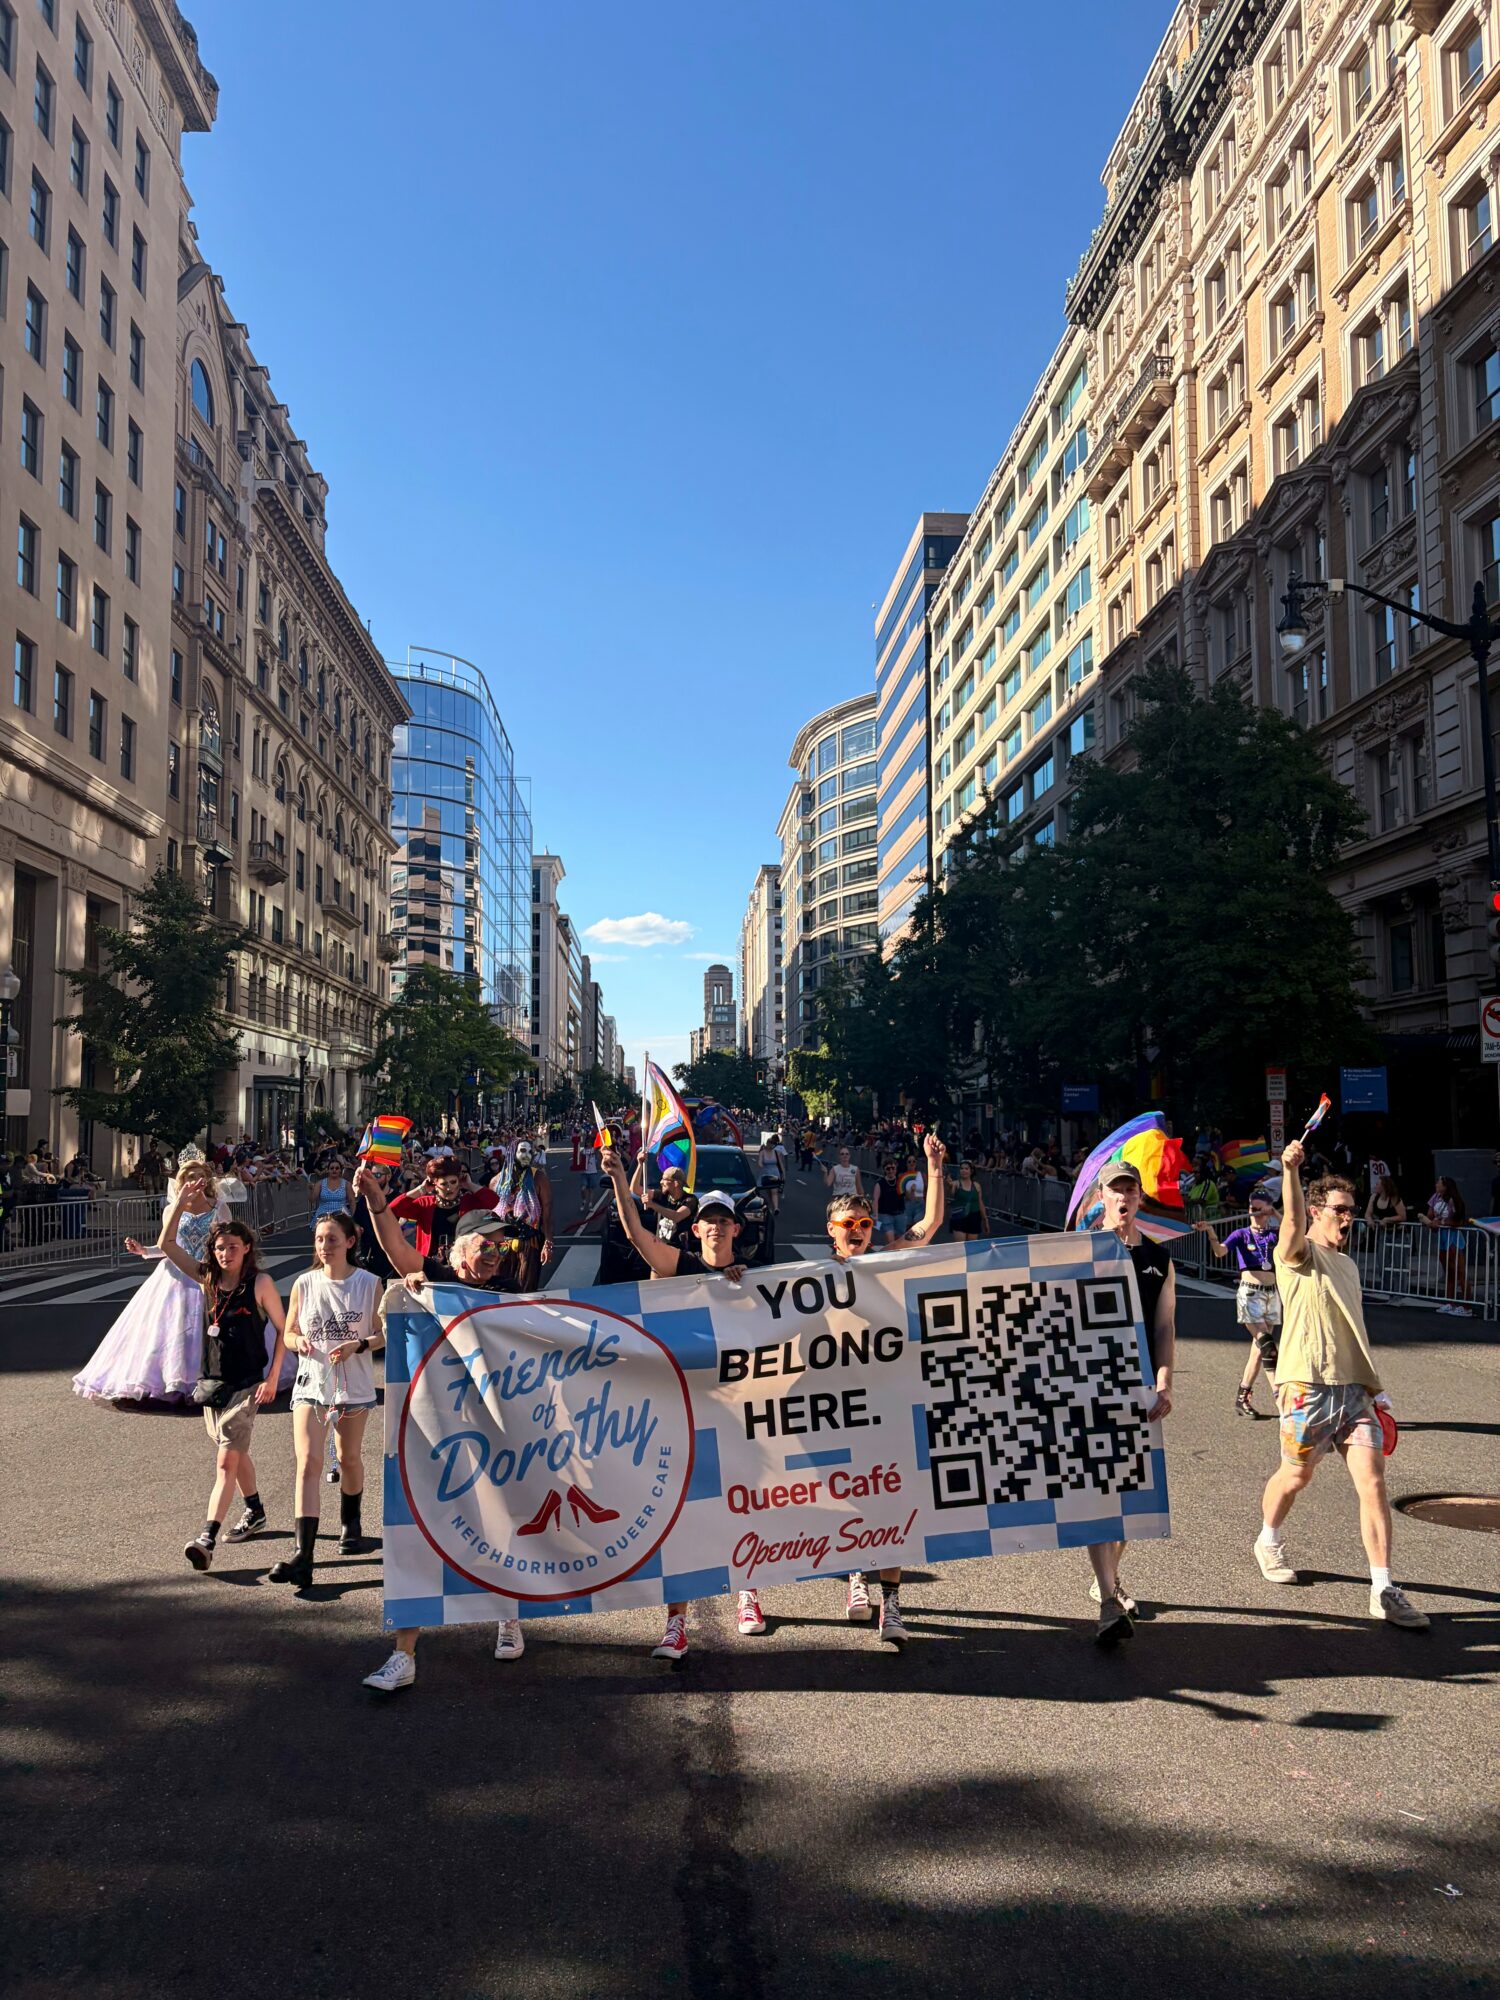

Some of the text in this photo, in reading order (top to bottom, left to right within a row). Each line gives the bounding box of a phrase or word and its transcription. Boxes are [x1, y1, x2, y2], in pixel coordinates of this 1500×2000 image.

[1372, 1163, 1386, 1176] 30
[756, 1271, 857, 1319] YOU
[441, 1319, 621, 1412] Friends
[719, 1326, 903, 1383] BELONG
[532, 1385, 558, 1430] of
[743, 1388, 882, 1441] HERE.
[430, 1380, 659, 1502] Dorothy
[451, 1445, 672, 1575] NEIGHBORHOOD QUEER CAFE
[726, 1462, 902, 1516] Queer Café
[732, 1508, 918, 1580] Opening Soon!
